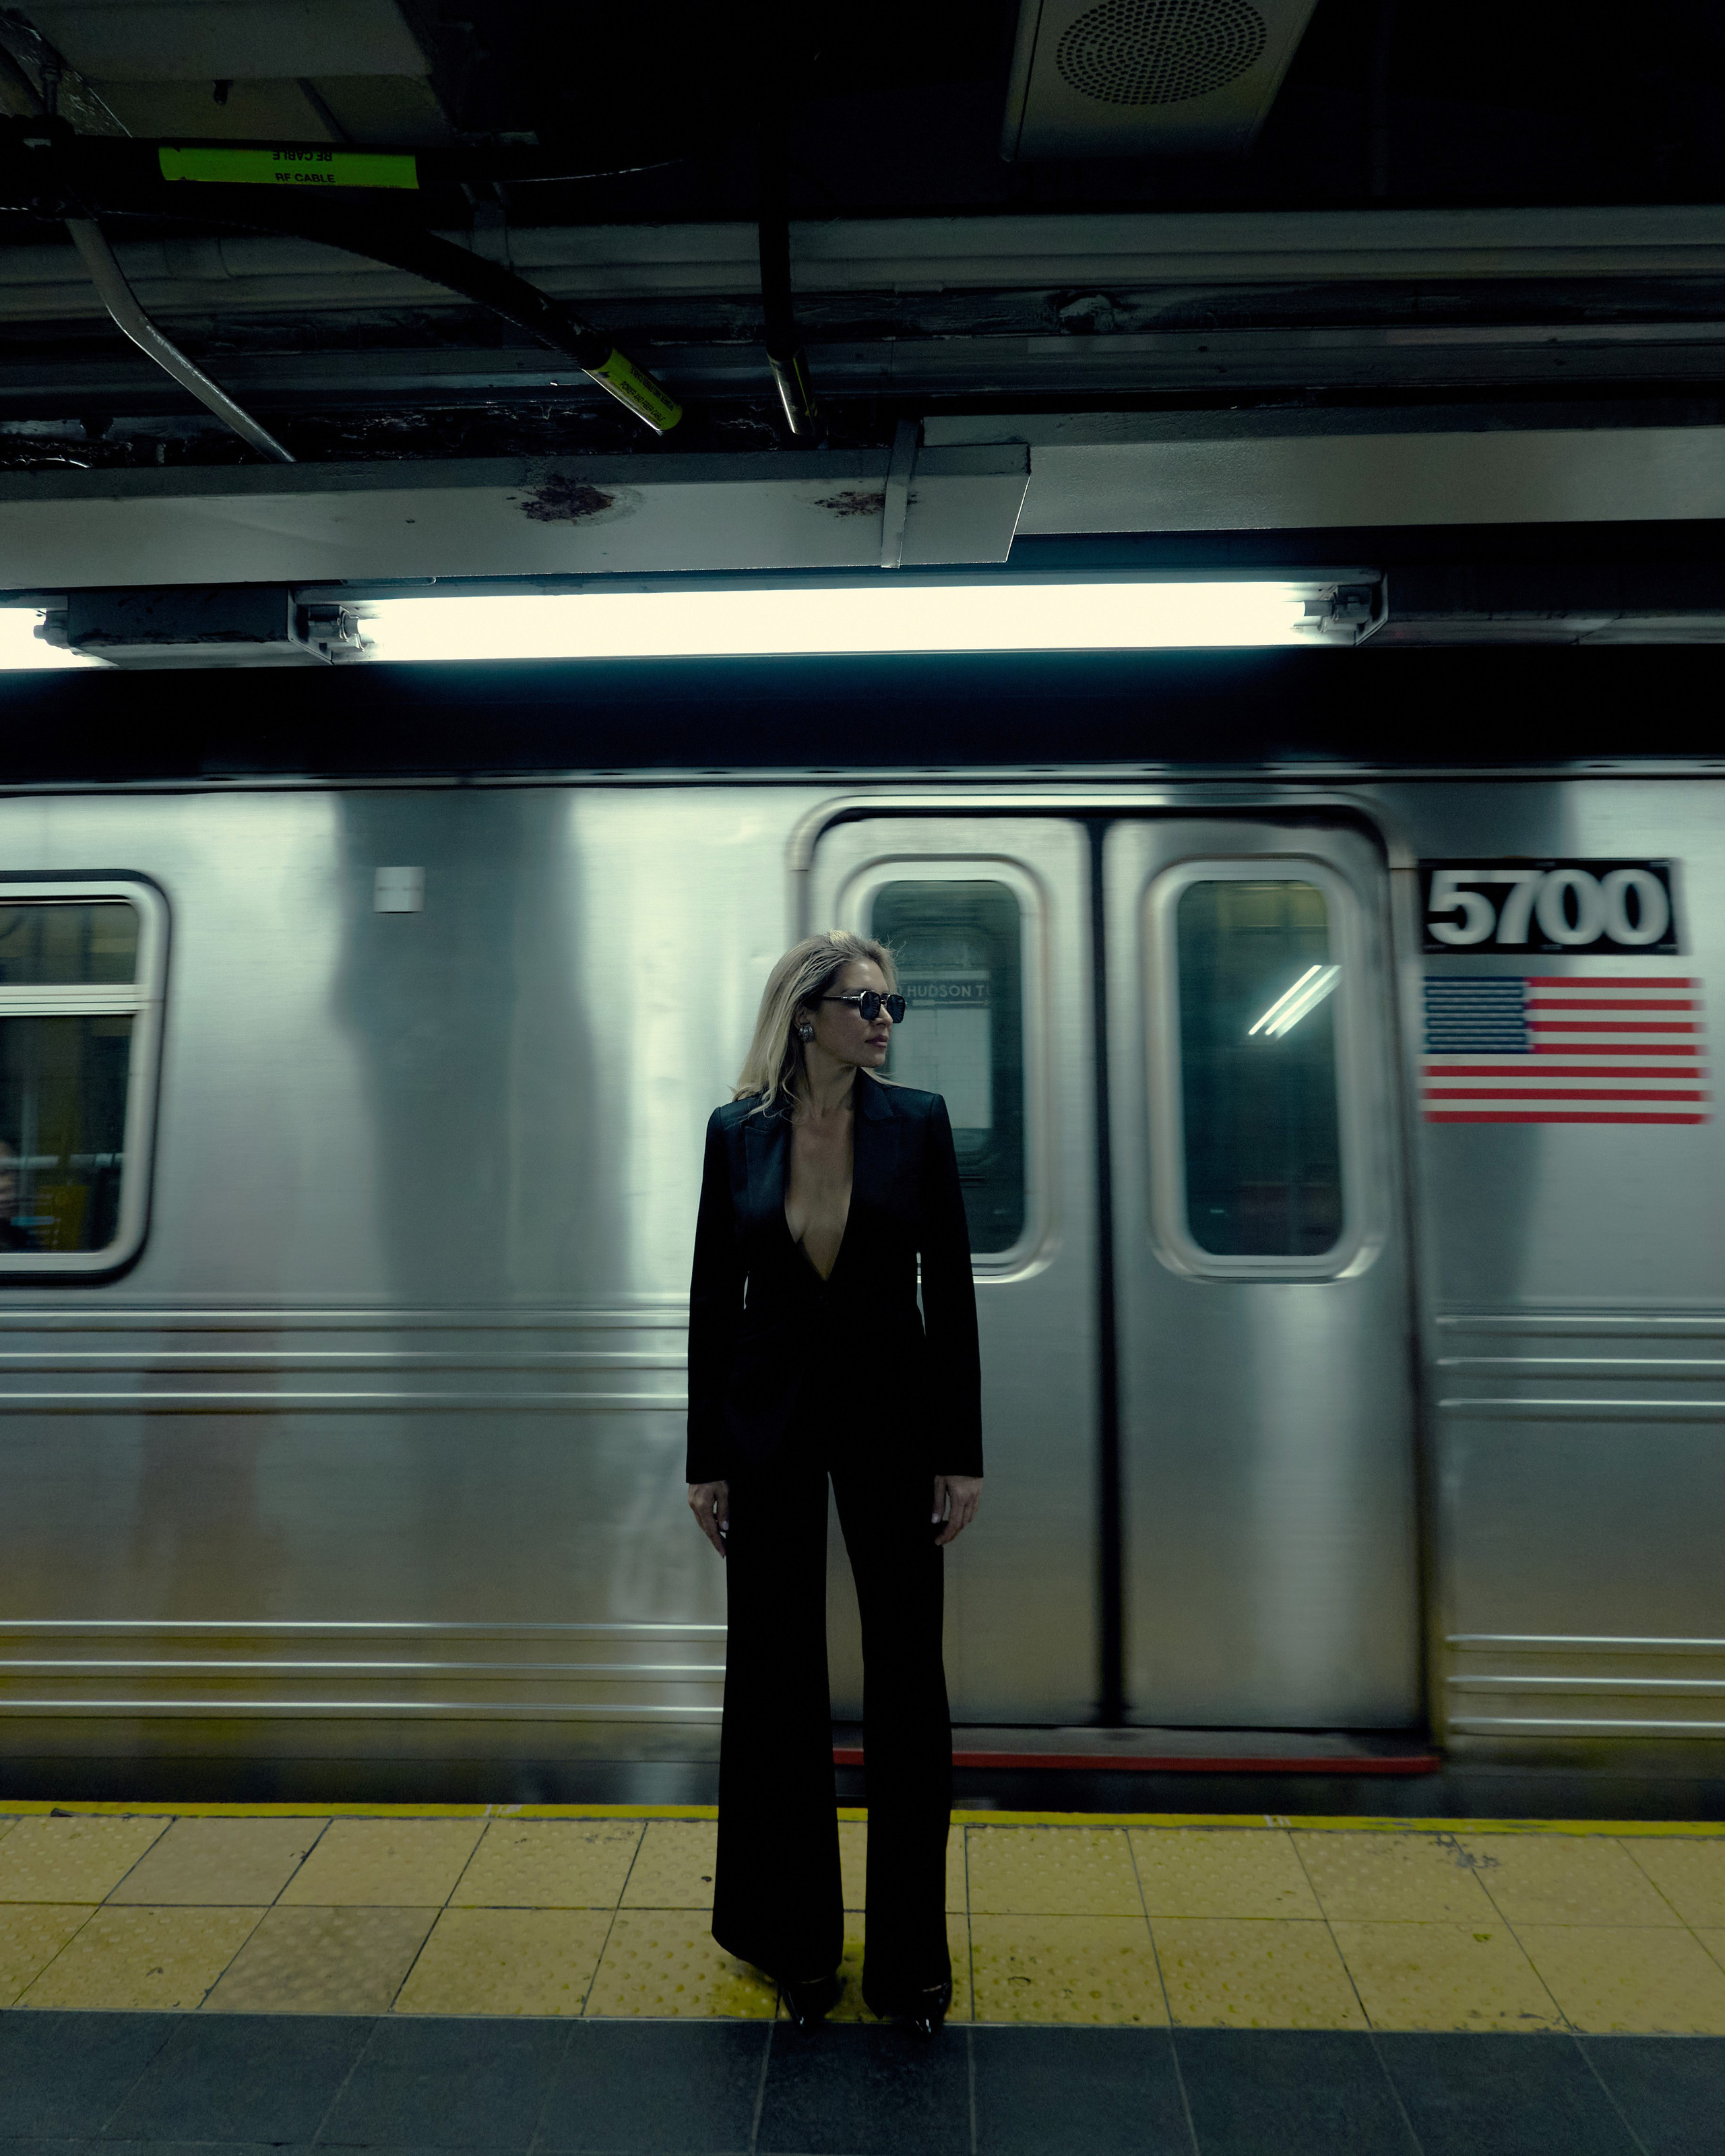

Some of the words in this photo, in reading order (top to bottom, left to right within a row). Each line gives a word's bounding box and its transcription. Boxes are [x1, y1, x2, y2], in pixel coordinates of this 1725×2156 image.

[272, 151, 313, 161] CABLE
[316, 151, 332, 161] RF
[275, 173, 291, 182] RF
[294, 174, 336, 183] CABLE
[620, 381, 636, 395] POWER
[650, 410, 666, 422] CABLE
[1426, 869, 1671, 945] 5700
[907, 985, 972, 997] HUDSON
